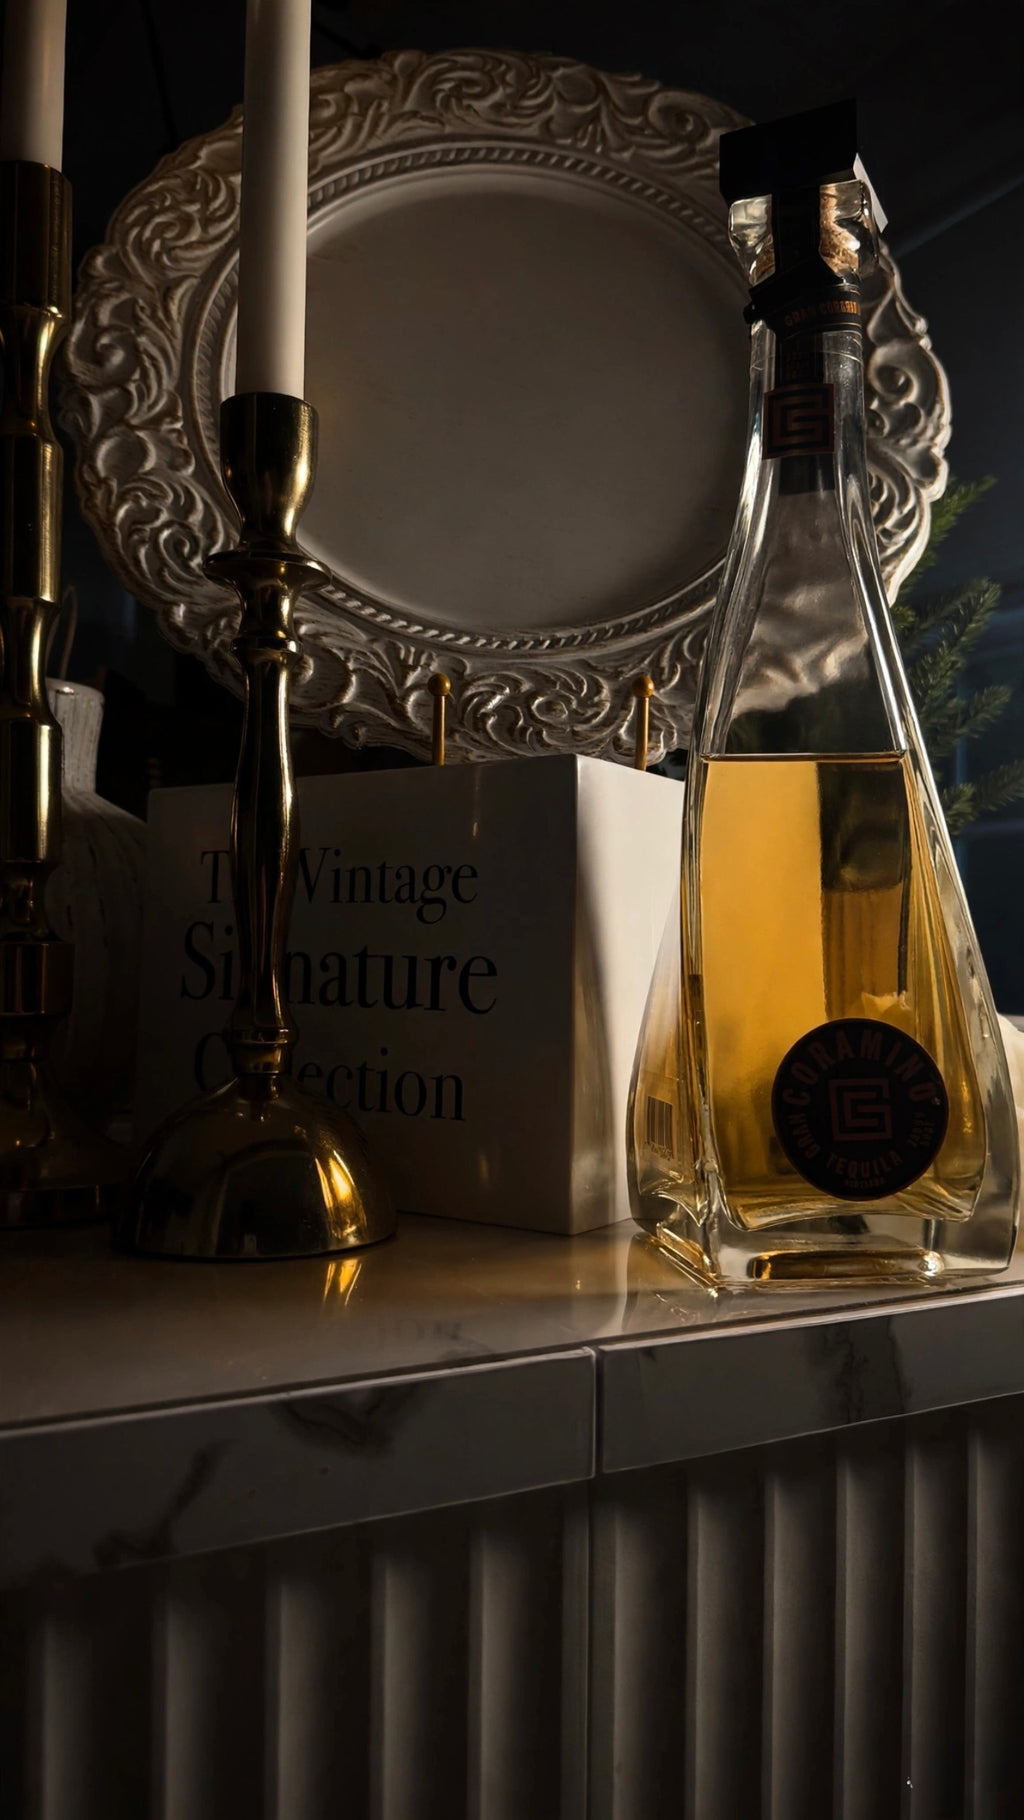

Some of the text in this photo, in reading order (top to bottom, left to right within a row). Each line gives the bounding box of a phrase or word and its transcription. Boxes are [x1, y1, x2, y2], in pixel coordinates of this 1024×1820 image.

[296, 847, 478, 924] Vintage
[181, 921, 497, 1015] Sinature
[194, 1031, 465, 1121] Cection
[781, 1029, 938, 1107] CORAMINO
[787, 1111, 823, 1160] GRAN
[825, 1148, 904, 1178] TEQUILA
